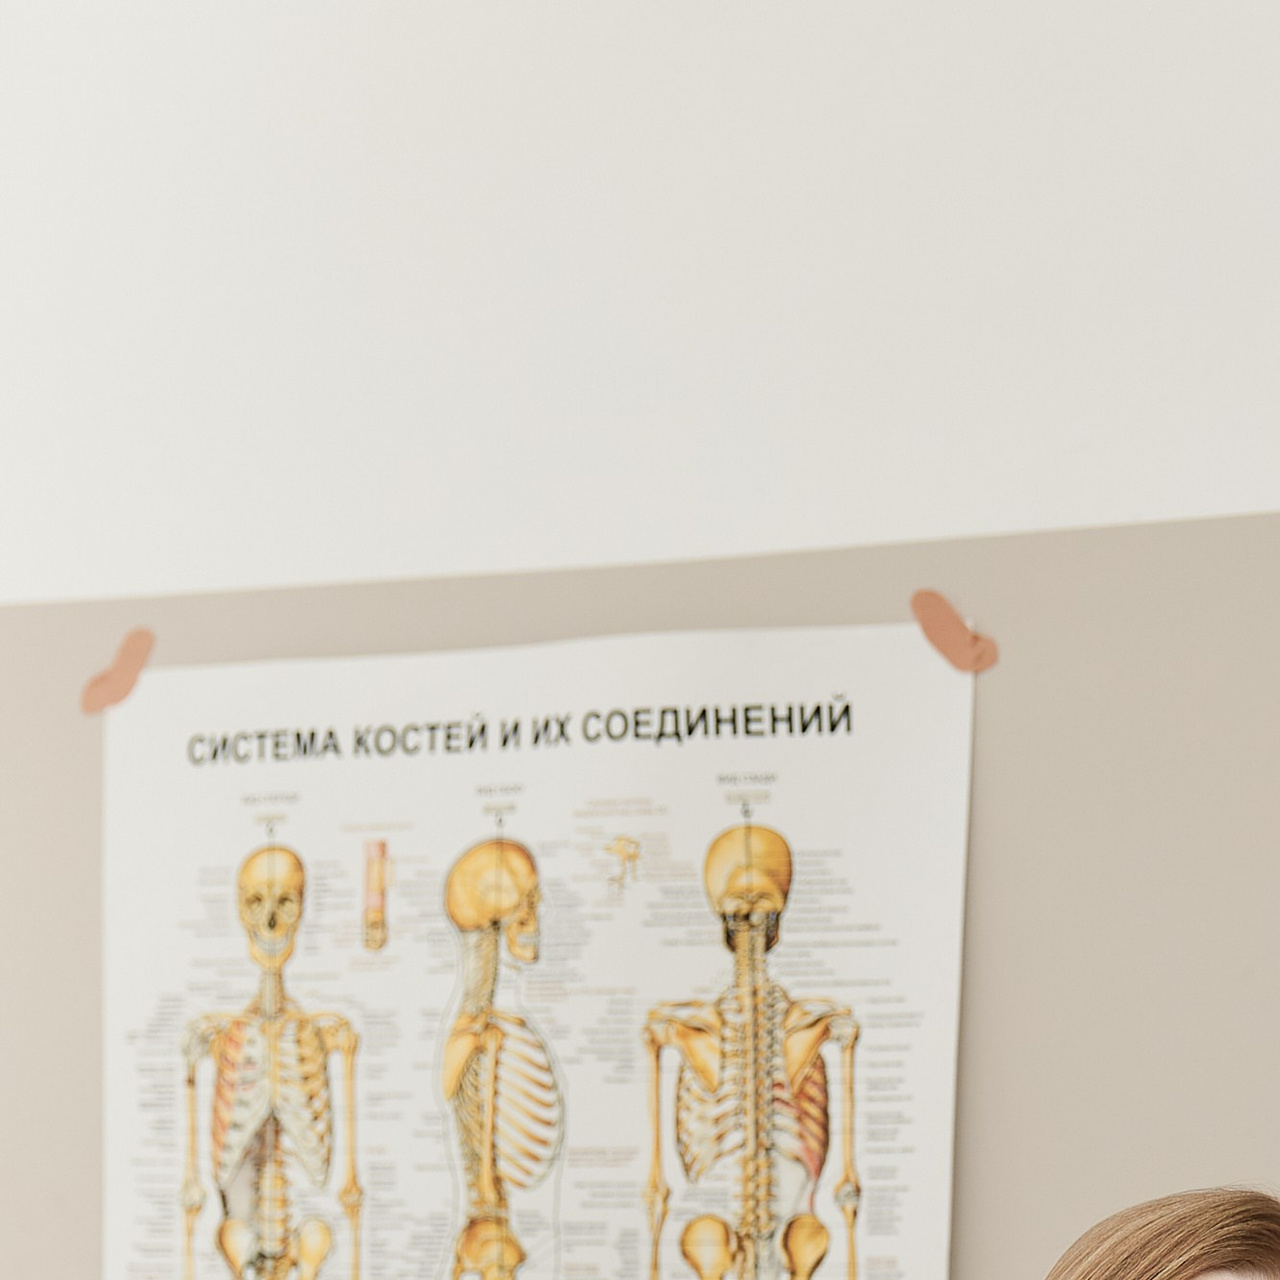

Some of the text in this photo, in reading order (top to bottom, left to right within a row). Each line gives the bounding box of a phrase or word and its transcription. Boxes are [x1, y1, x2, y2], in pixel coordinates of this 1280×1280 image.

[187, 692, 852, 767] СИСТЕМА КОСТЕЙ И ИХ СОЕДИНЕНИЙ
